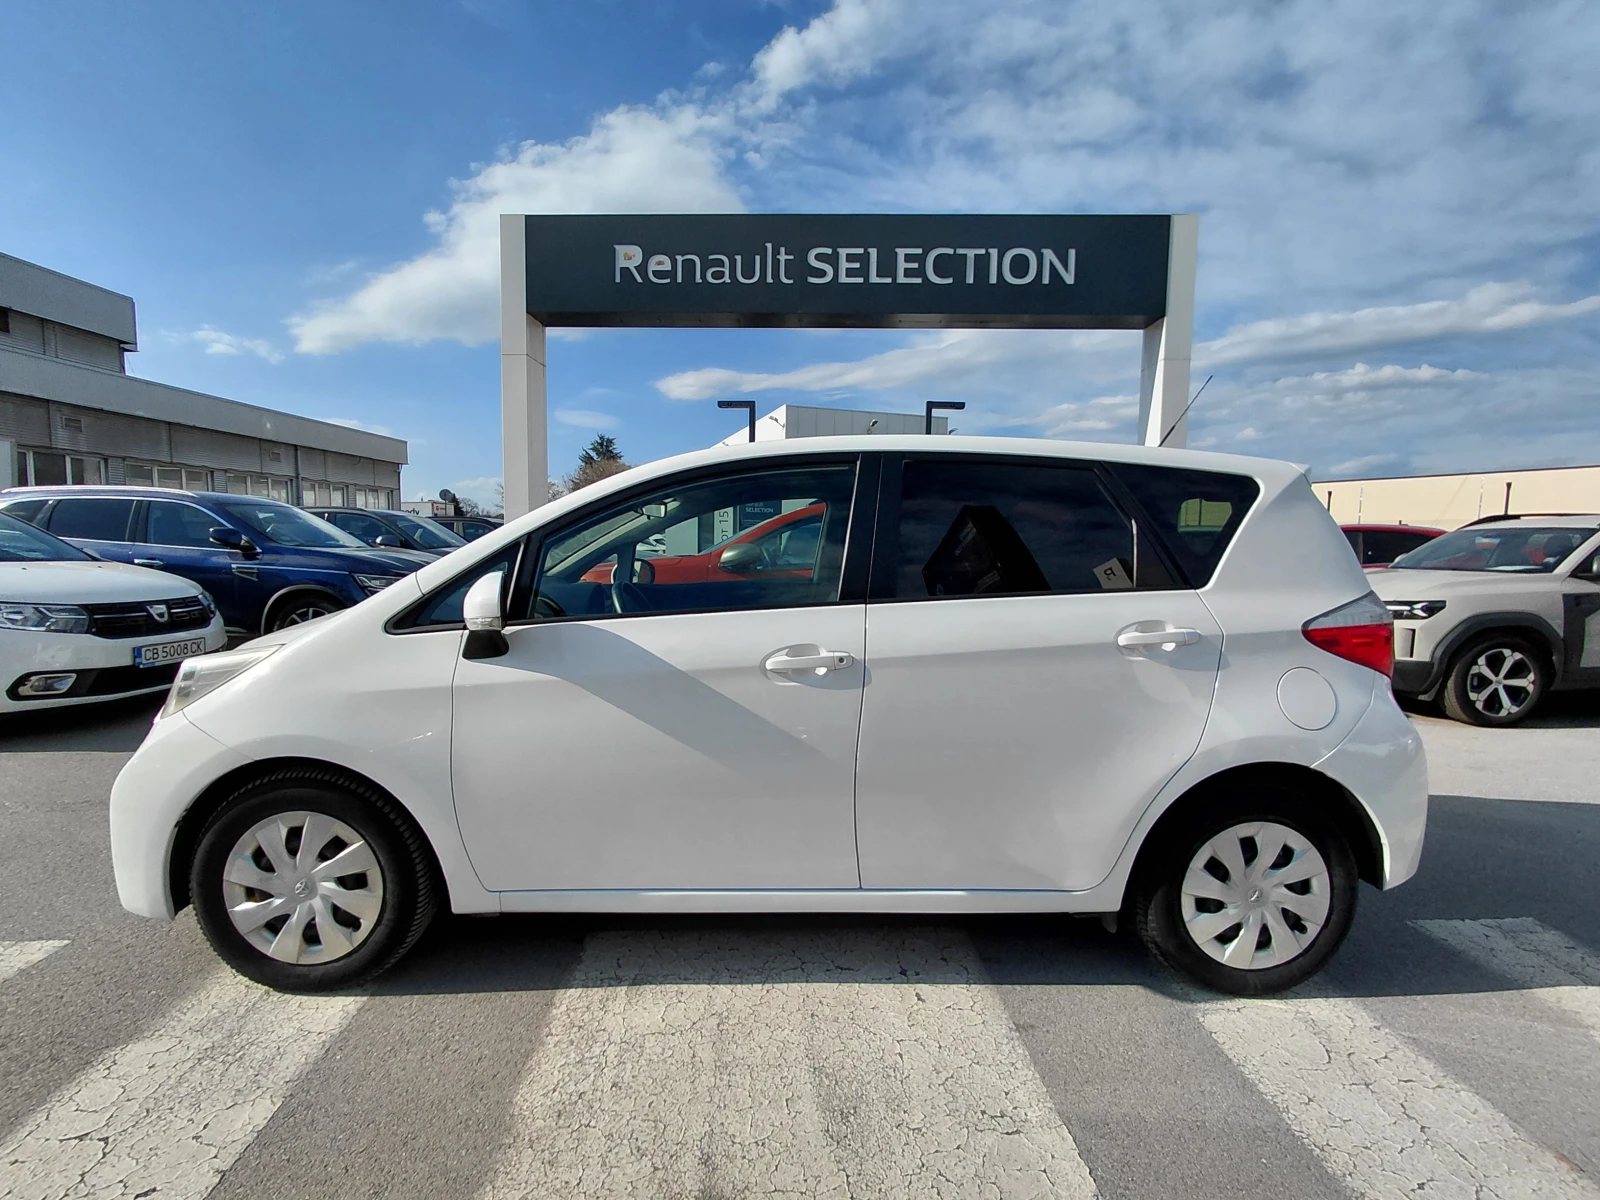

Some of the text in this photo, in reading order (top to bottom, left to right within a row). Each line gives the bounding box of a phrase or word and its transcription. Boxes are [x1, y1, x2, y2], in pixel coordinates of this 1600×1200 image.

[613, 243, 1076, 286] Renault SELECTION
[144, 641, 203, 661] CB 5008 CK
